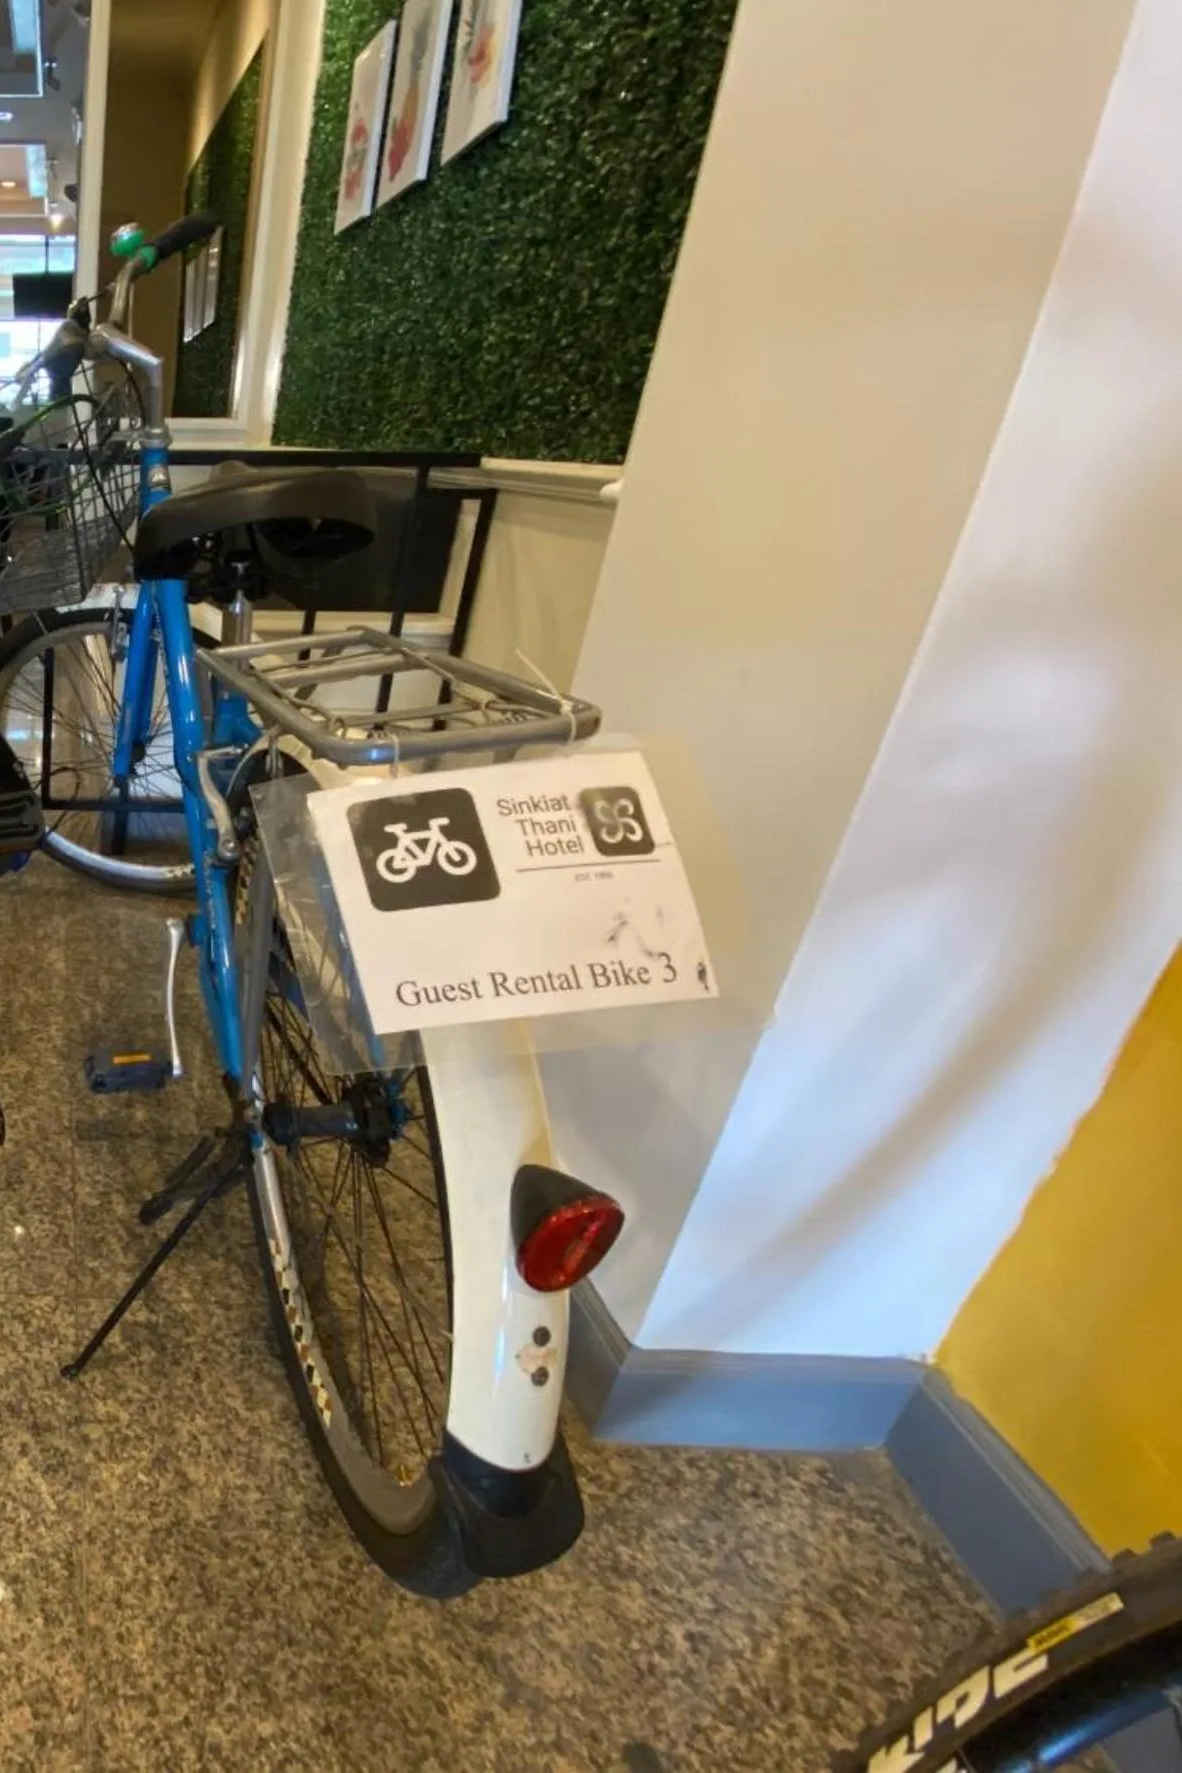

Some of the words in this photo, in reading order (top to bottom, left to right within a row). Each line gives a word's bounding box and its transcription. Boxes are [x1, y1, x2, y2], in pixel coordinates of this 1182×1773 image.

[497, 794, 571, 817] Sinkiat
[514, 814, 577, 837] Thani
[526, 835, 584, 857] Hotel
[395, 978, 483, 1007] Guest
[488, 964, 584, 998] Rental
[587, 960, 652, 988] Bike
[659, 952, 678, 983] 3
